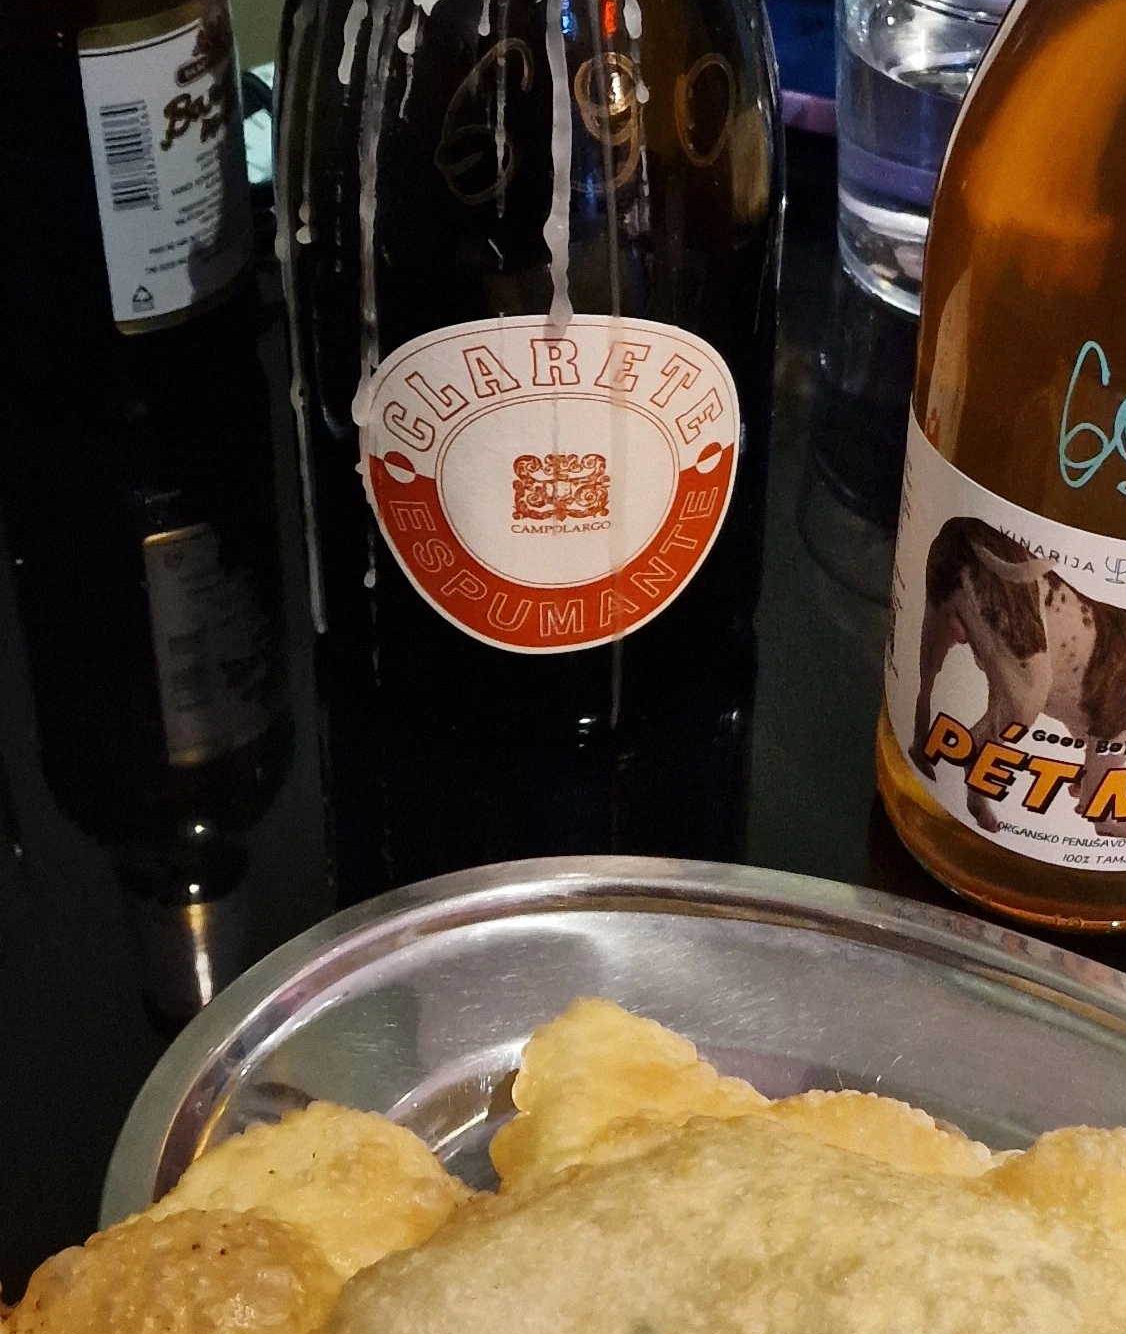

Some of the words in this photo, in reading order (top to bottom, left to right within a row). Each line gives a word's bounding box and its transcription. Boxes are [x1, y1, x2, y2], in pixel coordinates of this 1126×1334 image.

[382, 337, 724, 453] CLARETE
[510, 520, 611, 535] CAMPOLARGO
[999, 525, 1095, 574] VINARIJA
[389, 485, 719, 637] ESPUMANTE
[923, 712, 1085, 815] PÉT
[1031, 728, 1085, 750] GOOD
[998, 820, 1060, 845] ORGANSKO
[1061, 835, 1126, 849] PENUŠAVO
